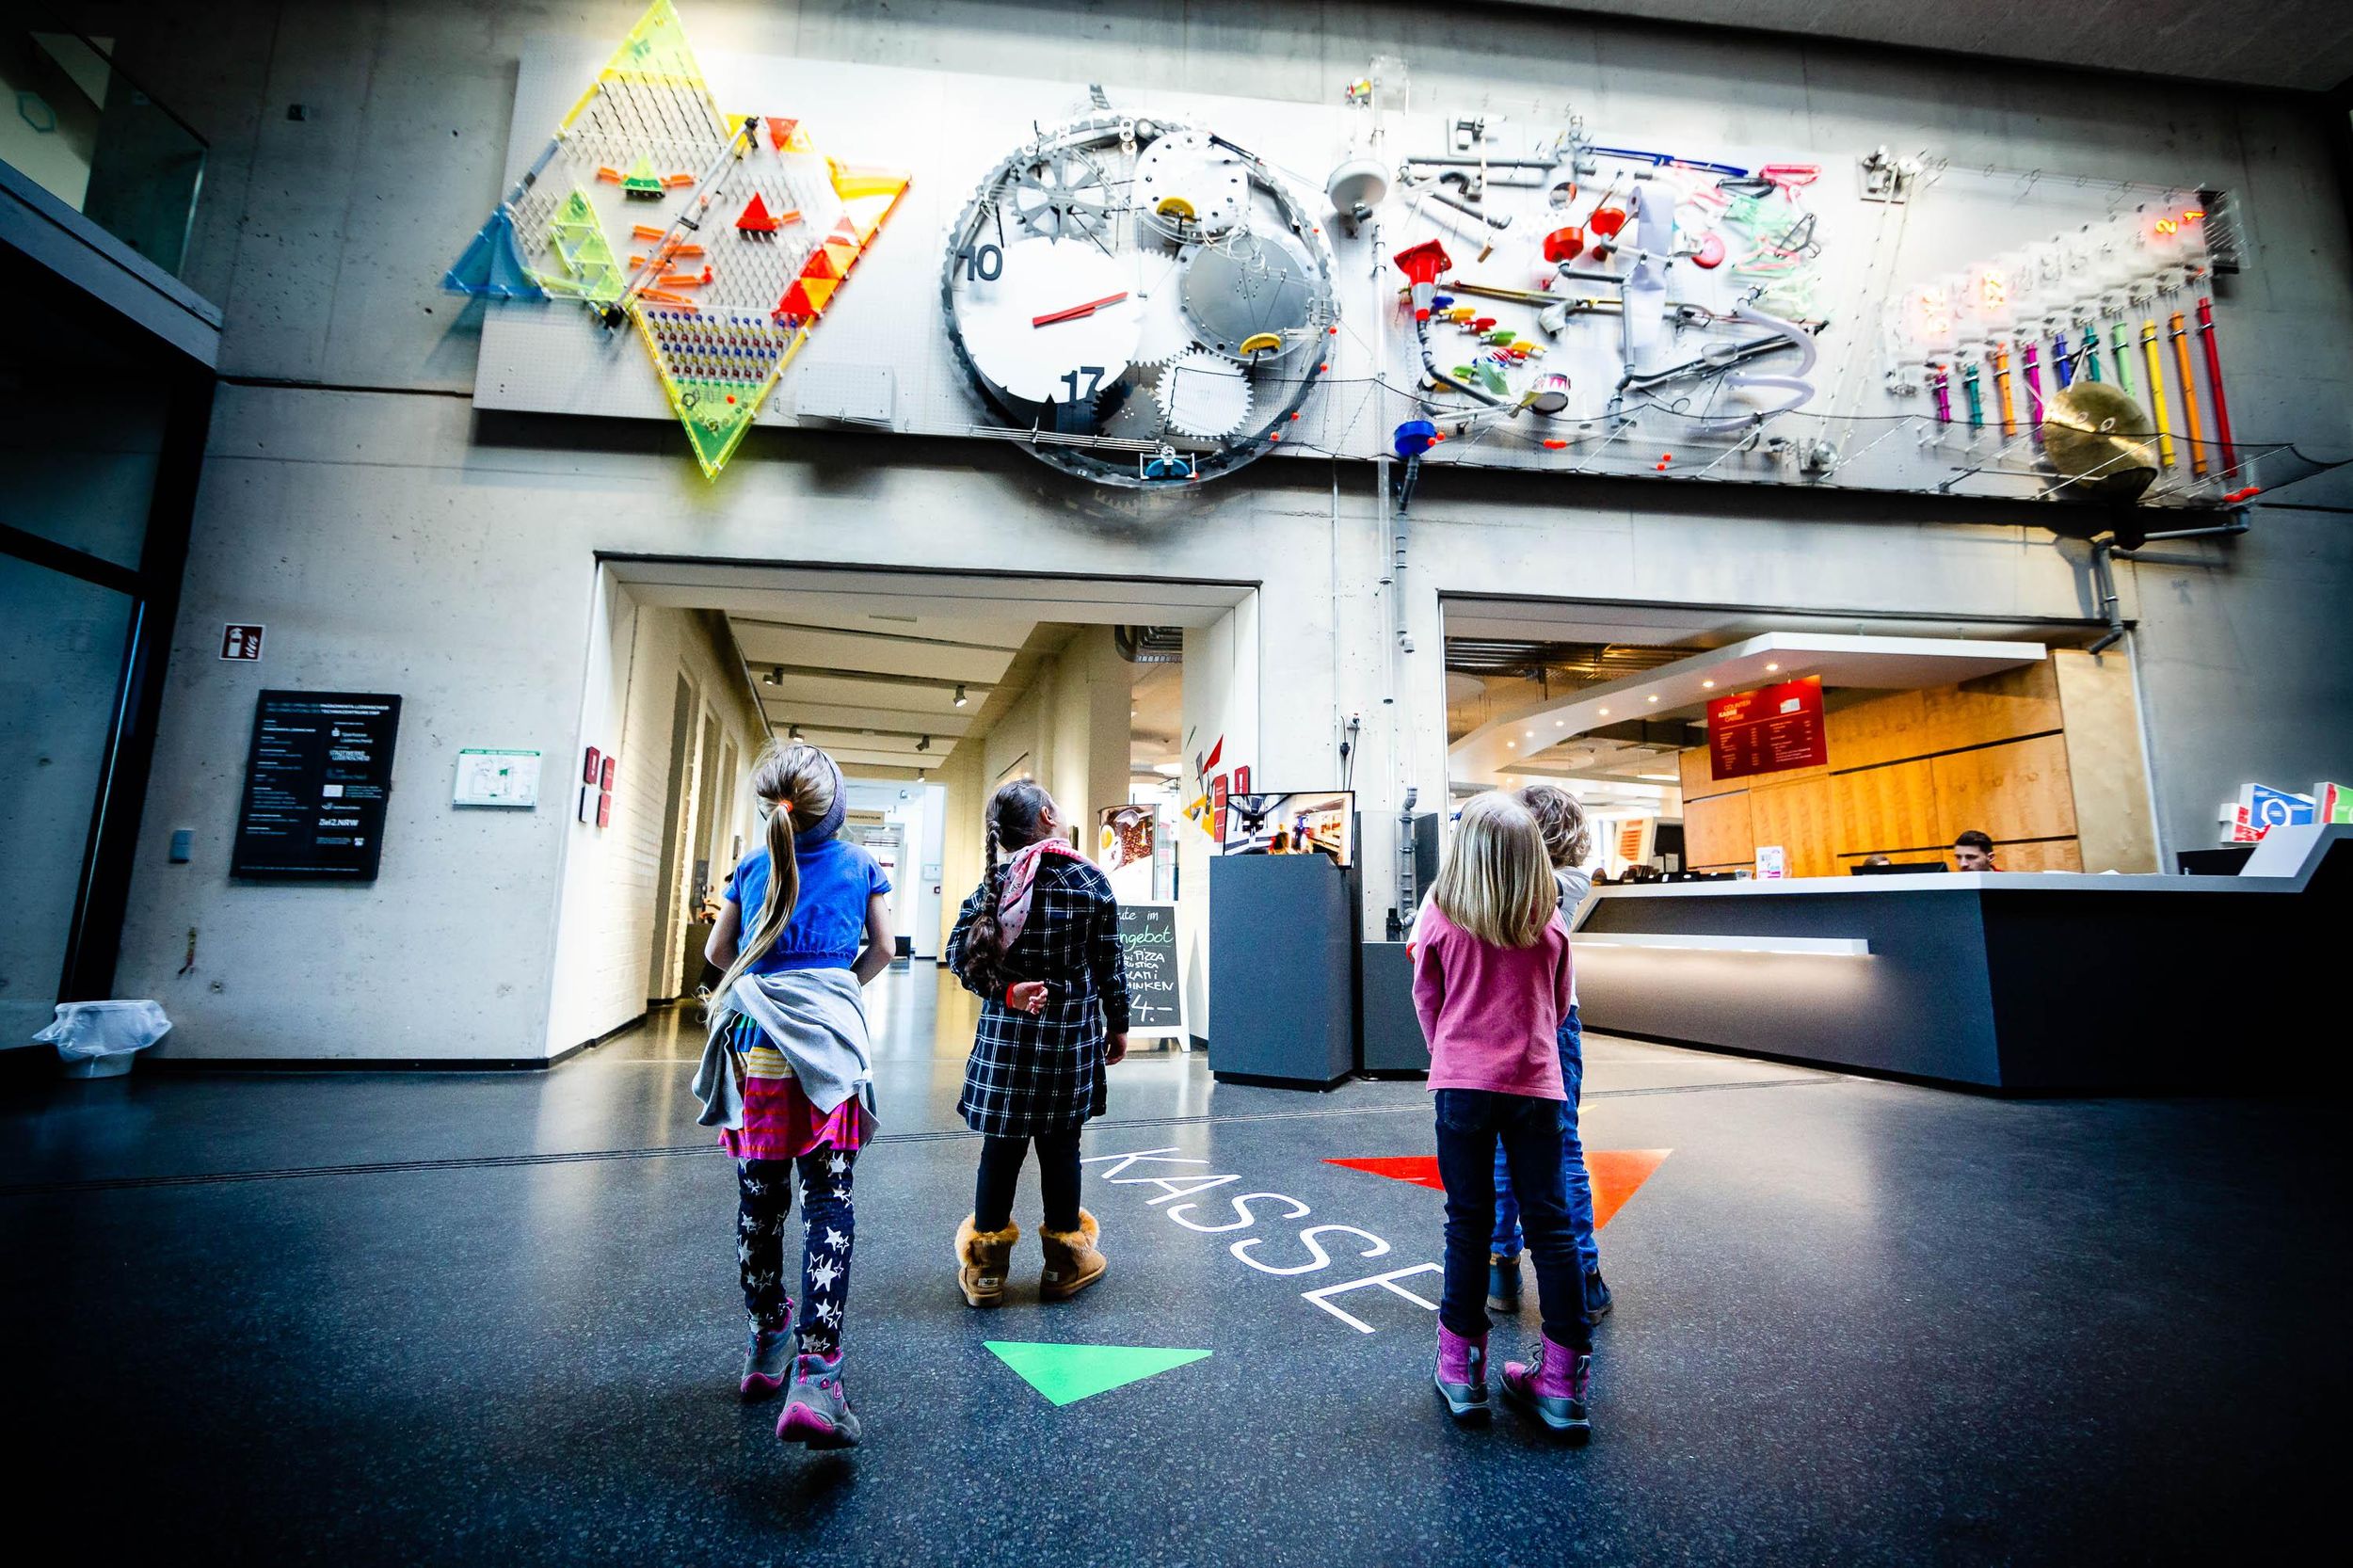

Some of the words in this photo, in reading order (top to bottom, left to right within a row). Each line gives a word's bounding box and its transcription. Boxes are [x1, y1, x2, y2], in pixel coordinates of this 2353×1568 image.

[959, 244, 1003, 281] 10
[1061, 366, 1105, 408] 17
[1118, 906, 1137, 920] ute
[1147, 910, 1160, 921] im
[1119, 924, 1175, 952] ngebot
[1080, 1146, 1444, 1335] KASSE
